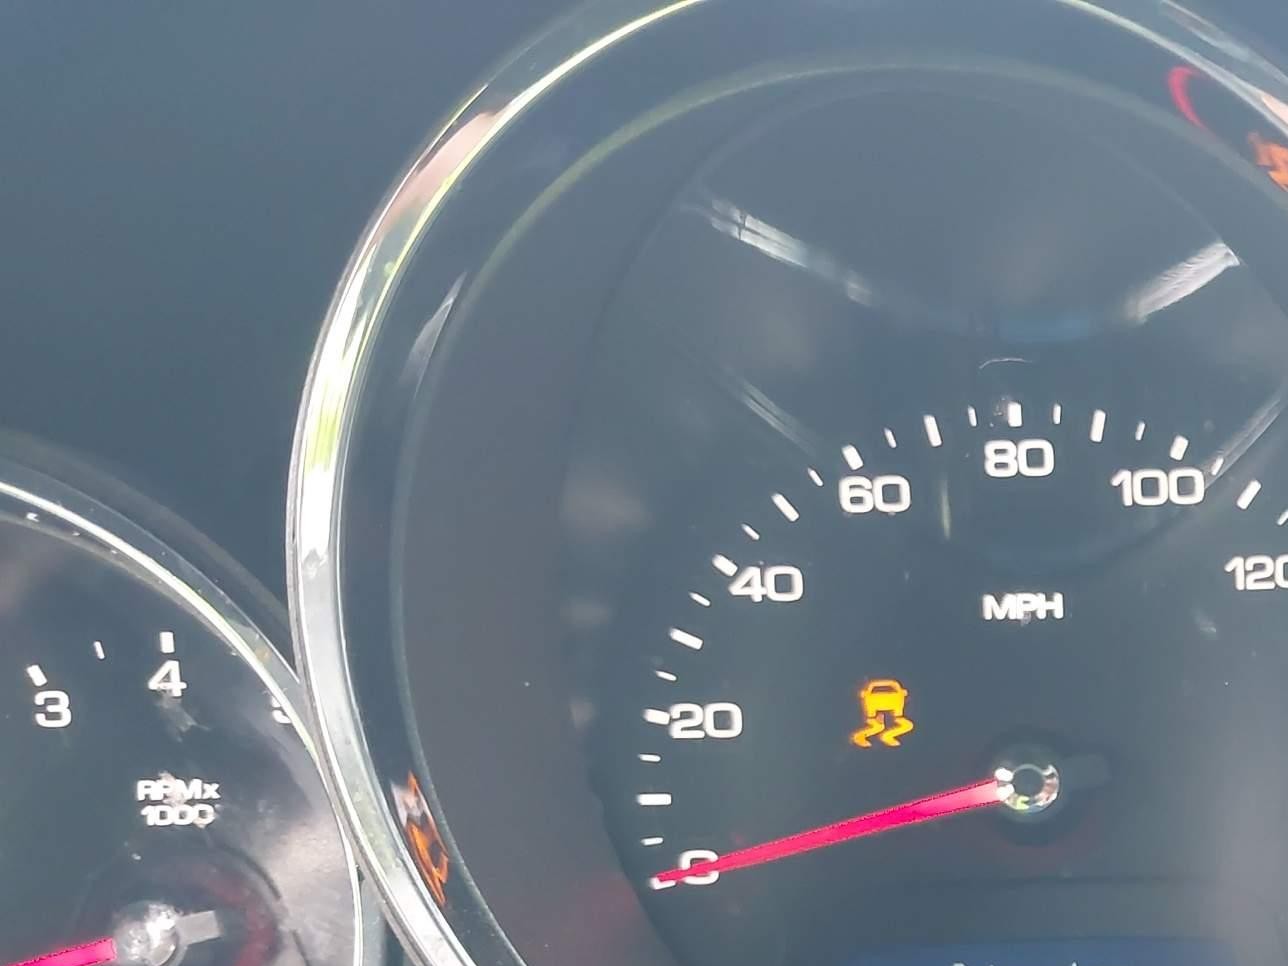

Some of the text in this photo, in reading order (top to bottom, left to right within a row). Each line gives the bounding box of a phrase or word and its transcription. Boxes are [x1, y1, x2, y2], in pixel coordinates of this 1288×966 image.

[984, 439, 1054, 477] 80
[839, 476, 911, 513] 60
[1111, 467, 1205, 506] 100
[729, 566, 804, 601] 40
[983, 593, 1063, 620] MPH
[148, 661, 187, 697] 4
[34, 692, 72, 729] 3
[668, 703, 743, 739] 20
[141, 803, 215, 827] 1000
